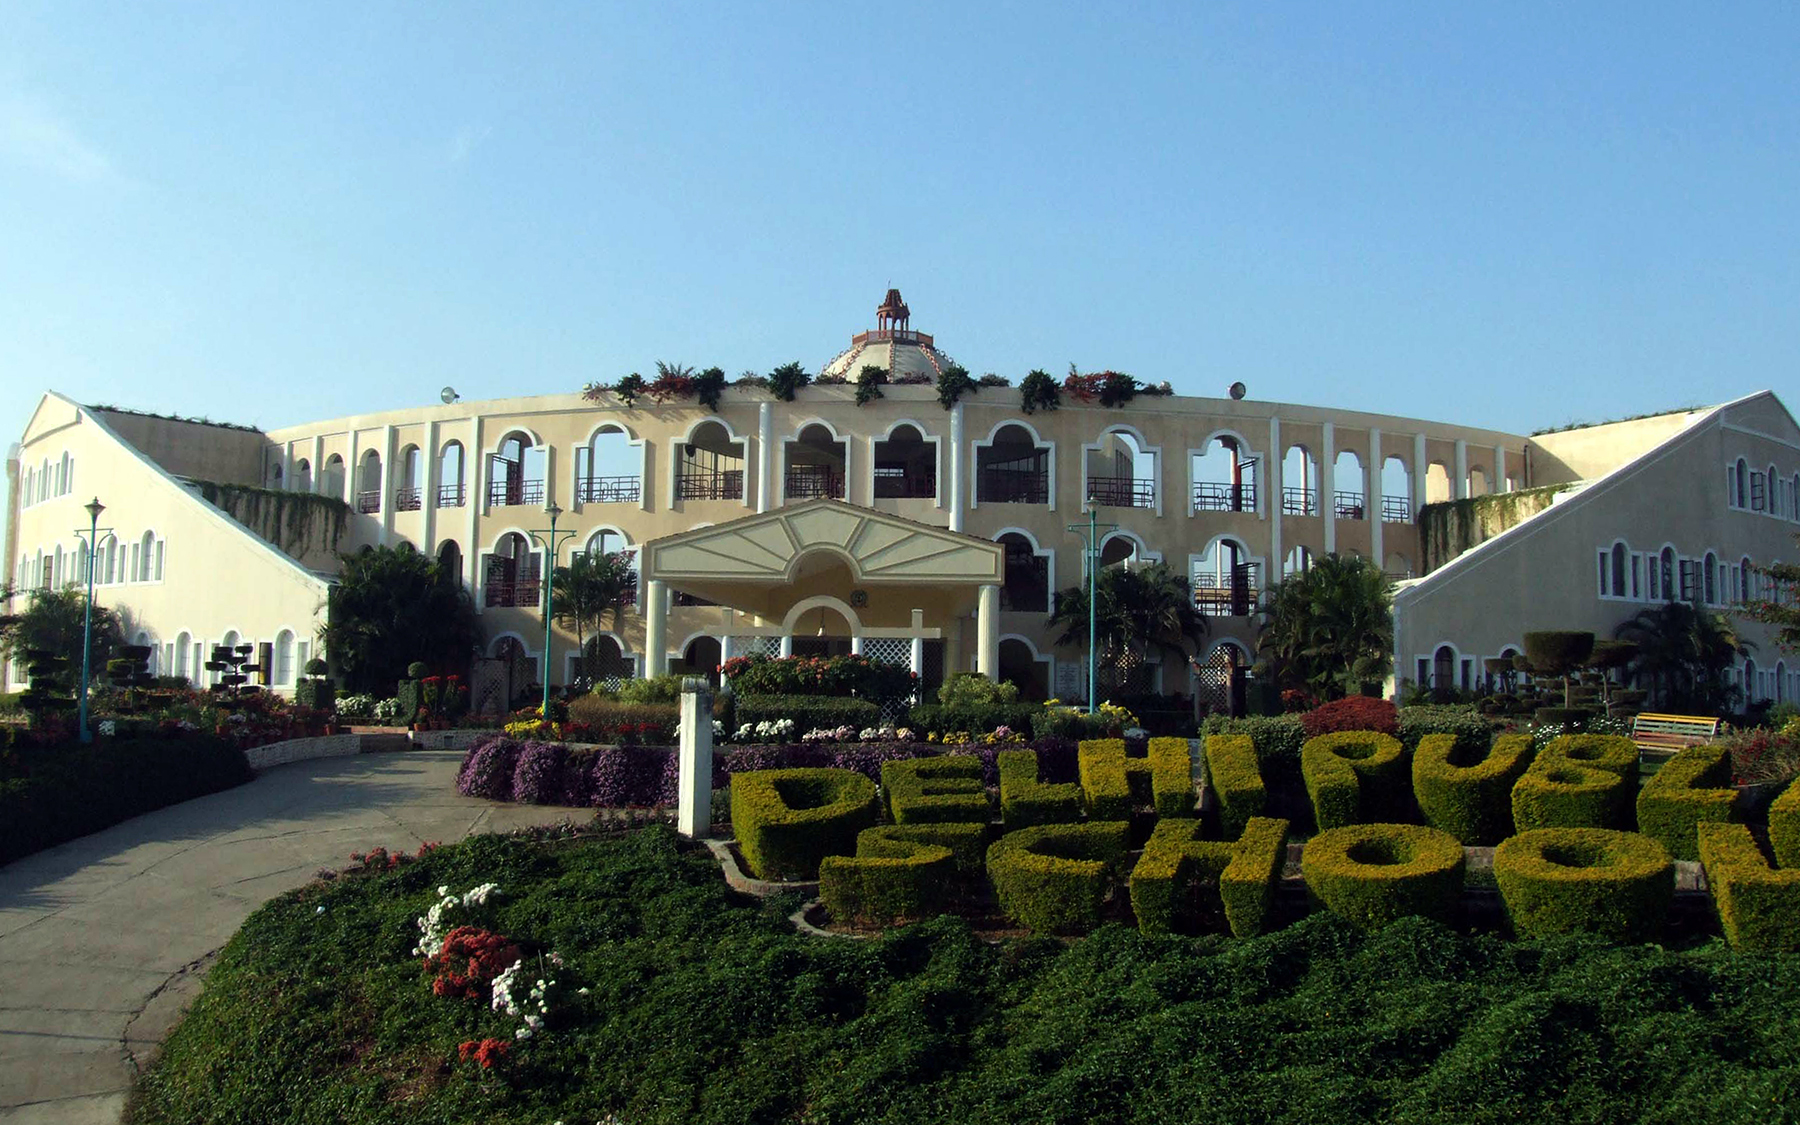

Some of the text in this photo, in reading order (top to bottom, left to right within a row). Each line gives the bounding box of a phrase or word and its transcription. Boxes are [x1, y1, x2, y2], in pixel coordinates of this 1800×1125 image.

[730, 730, 1800, 880] DELHI PUBL
[818, 816, 1800, 948] SCHOOL
